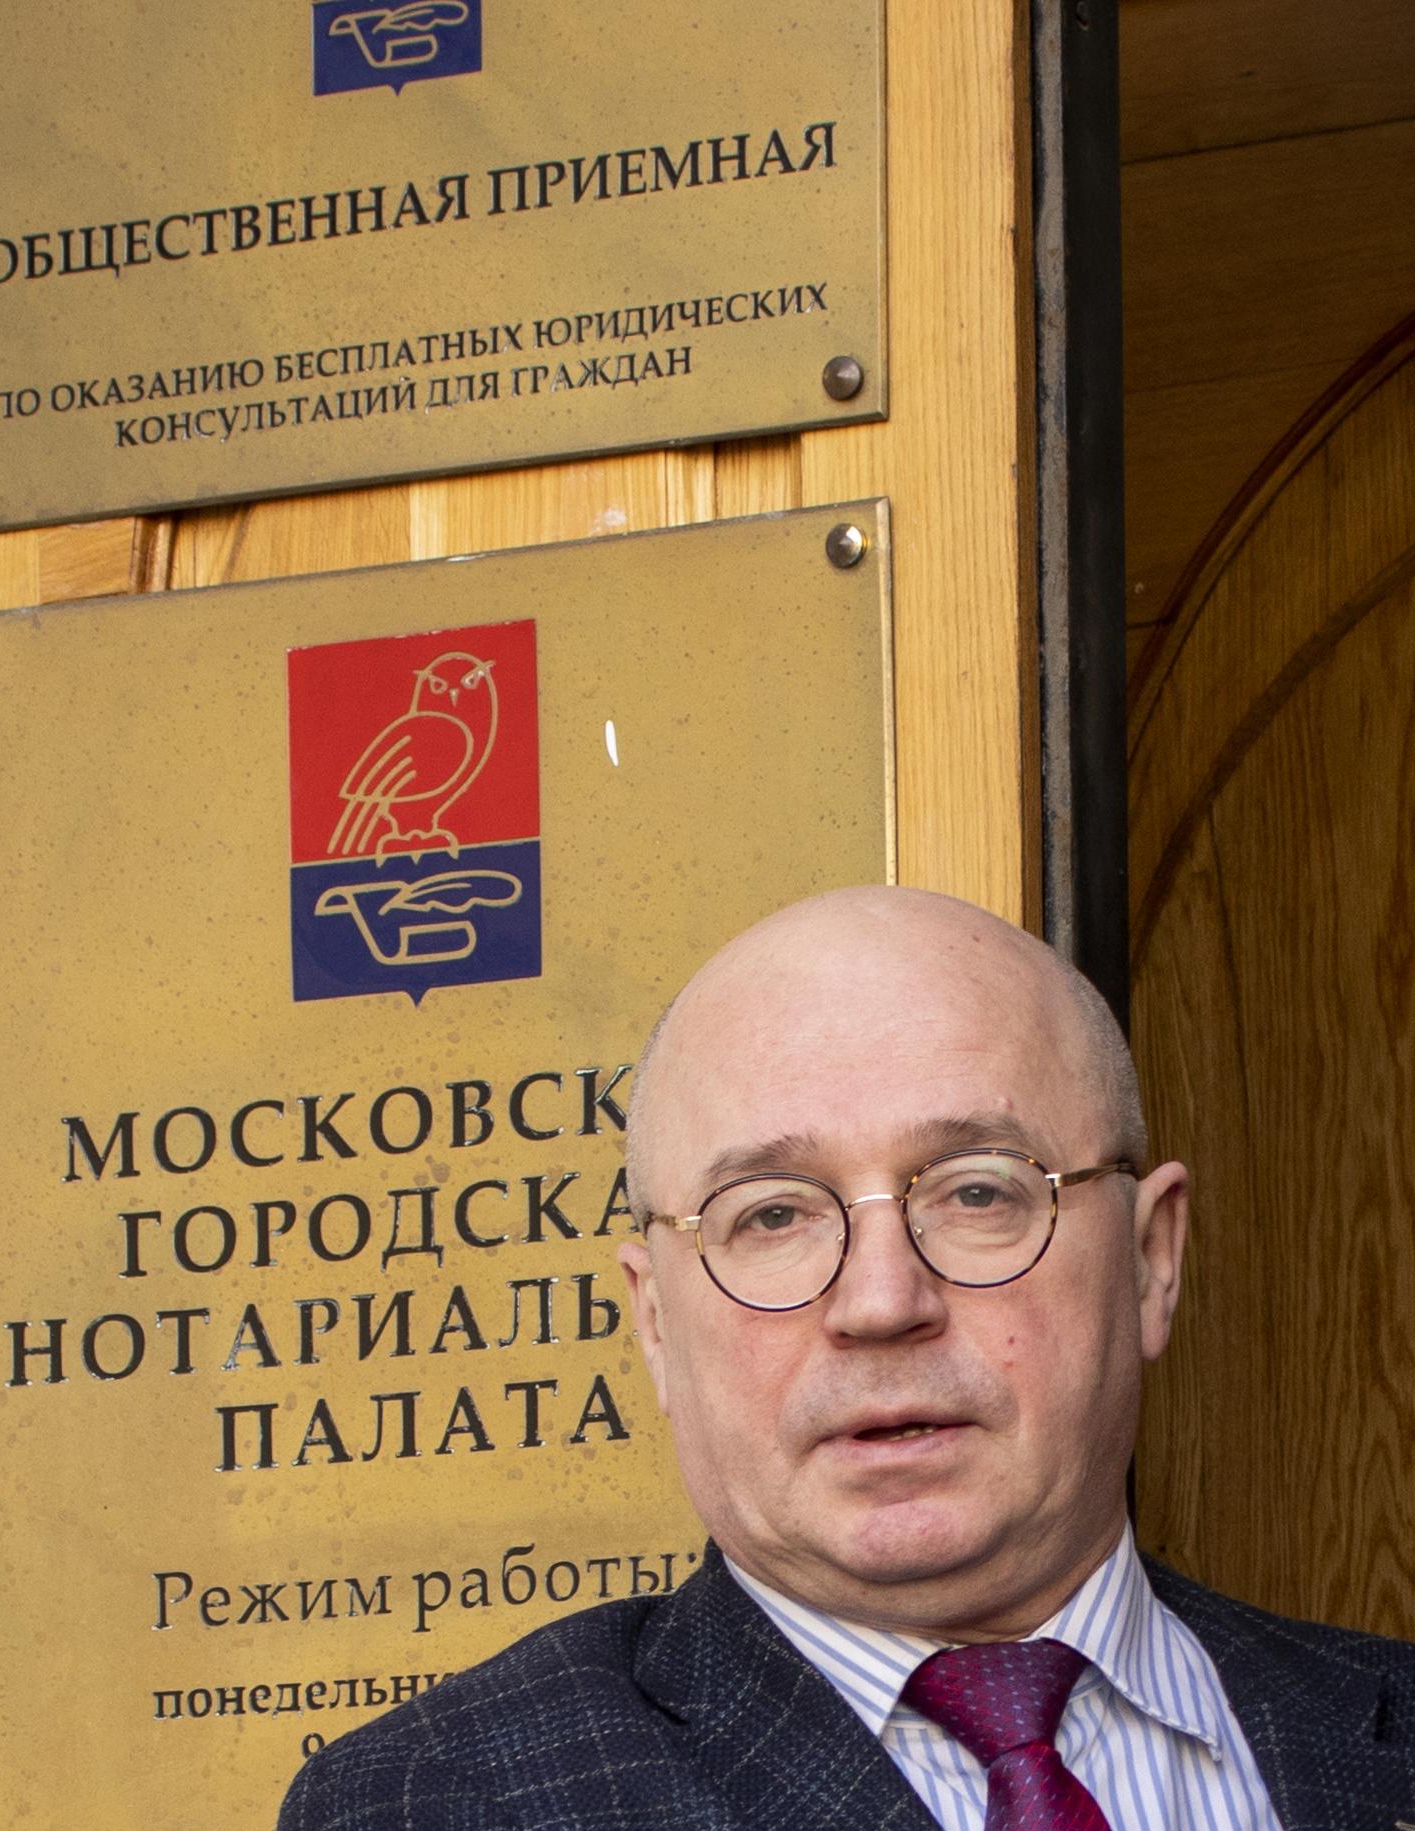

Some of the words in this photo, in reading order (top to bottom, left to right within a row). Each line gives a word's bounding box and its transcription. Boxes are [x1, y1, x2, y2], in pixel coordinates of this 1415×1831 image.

[486, 121, 838, 217] ПРИЕМНАЯ
[50, 358, 265, 413] ОКАЗАНИЮ
[274, 322, 523, 383] БЕСПЛАТНЫХ
[532, 282, 828, 348] ЮРИДИЧЕСКИХ
[115, 376, 418, 448] КОНСУЛЬТАЦИЙ
[425, 372, 501, 414] ДЛЯ
[509, 346, 692, 398] ГРАЖДАН
[60, 1063, 634, 1184] МОСКОВСК
[117, 1167, 641, 1278] ГОРОДСКА
[3, 1273, 638, 1388] НОТАРИАЛЬ
[213, 1374, 631, 1473] ПАЛАТА
[151, 1569, 393, 1631] Режим
